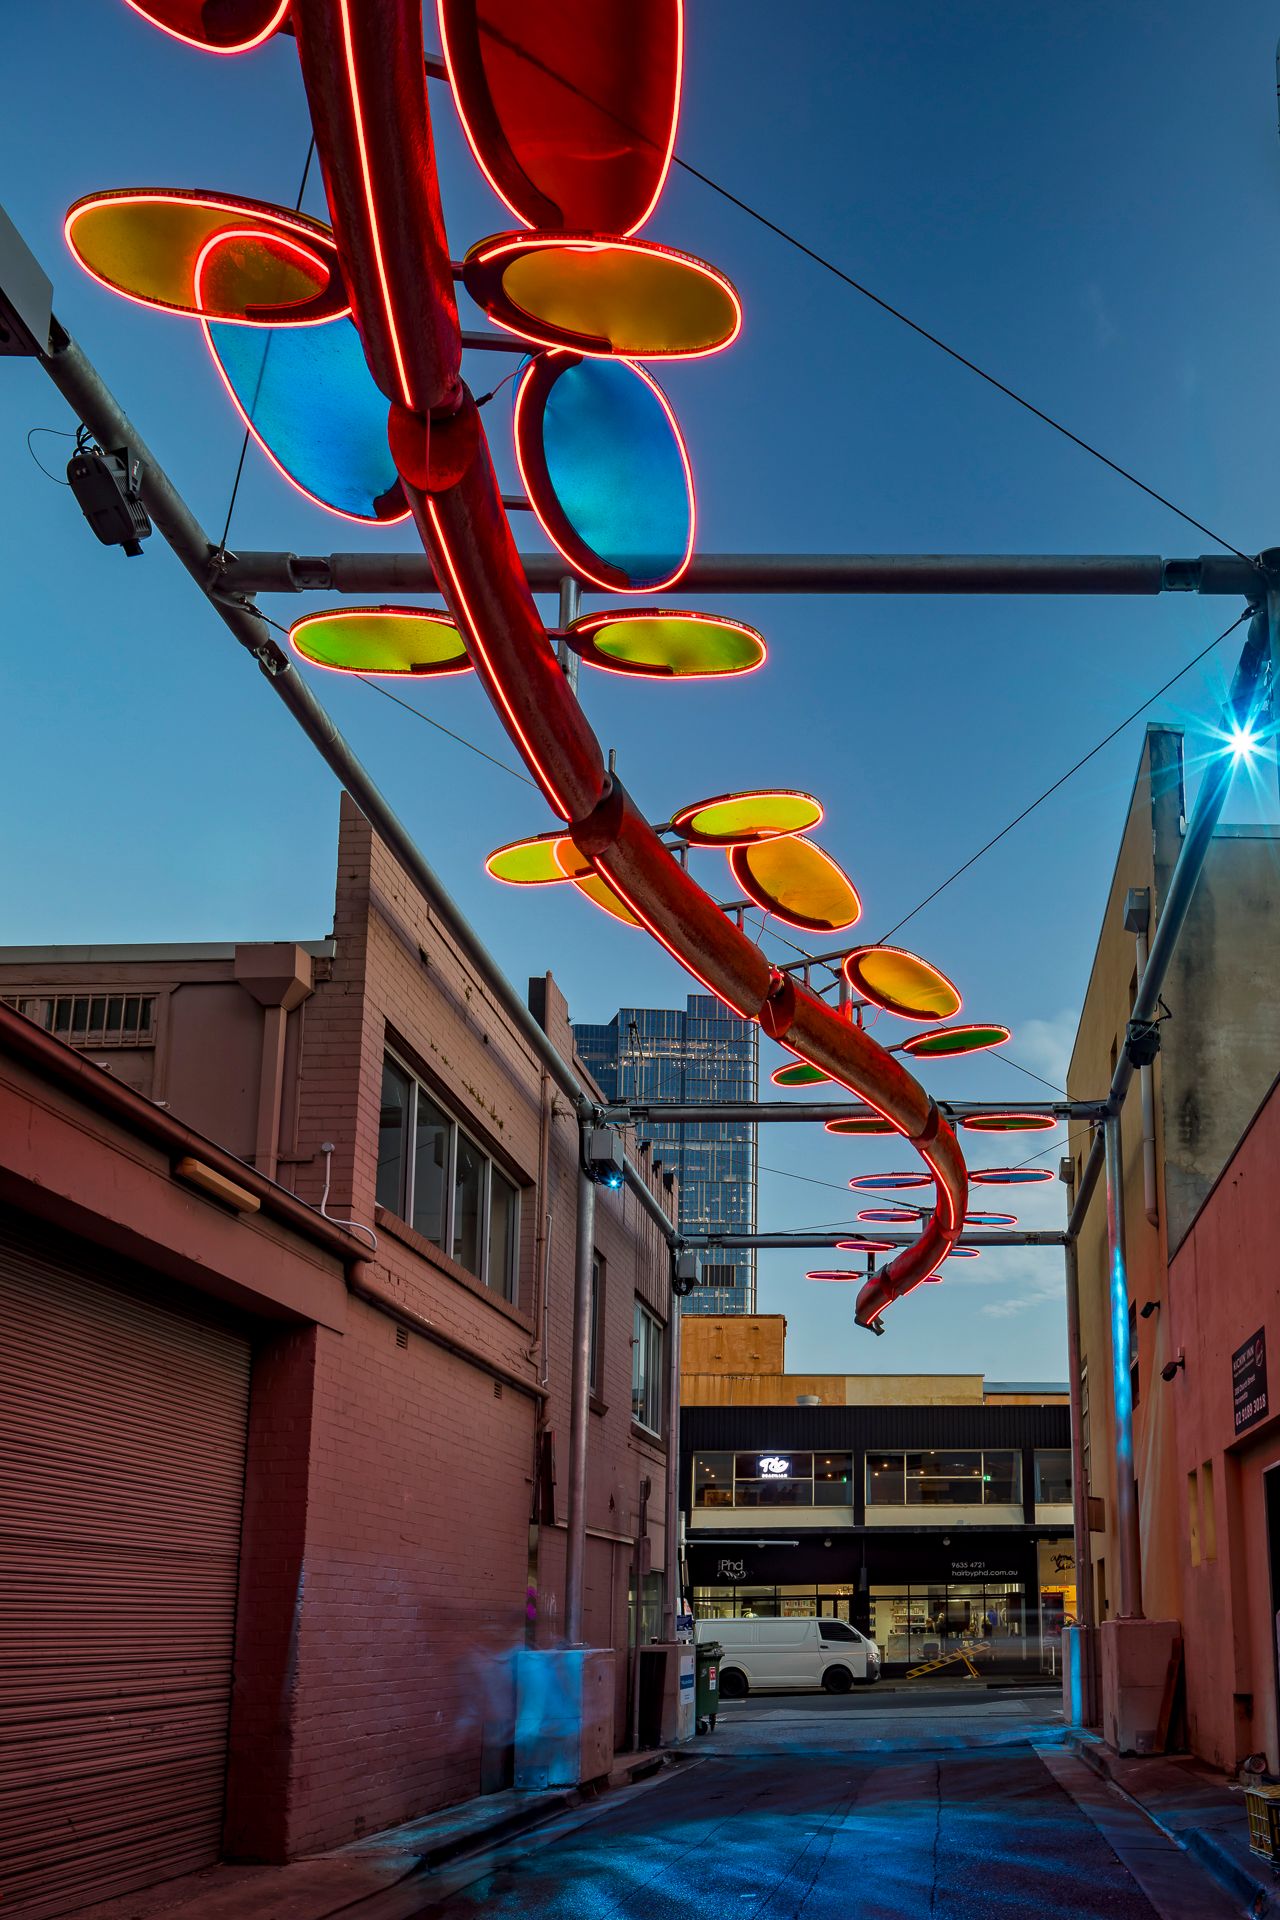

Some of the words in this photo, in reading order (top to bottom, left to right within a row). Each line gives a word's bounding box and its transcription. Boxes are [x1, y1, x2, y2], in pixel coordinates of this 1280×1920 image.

[1253, 1393, 1266, 1414] 3018
[759, 1456, 789, 1474] Rio
[721, 1559, 744, 1571] Phd
[951, 1561, 968, 1569] 9635
[969, 1561, 985, 1569] 4721
[951, 1569, 1018, 1579] hairbyphd.com.au
